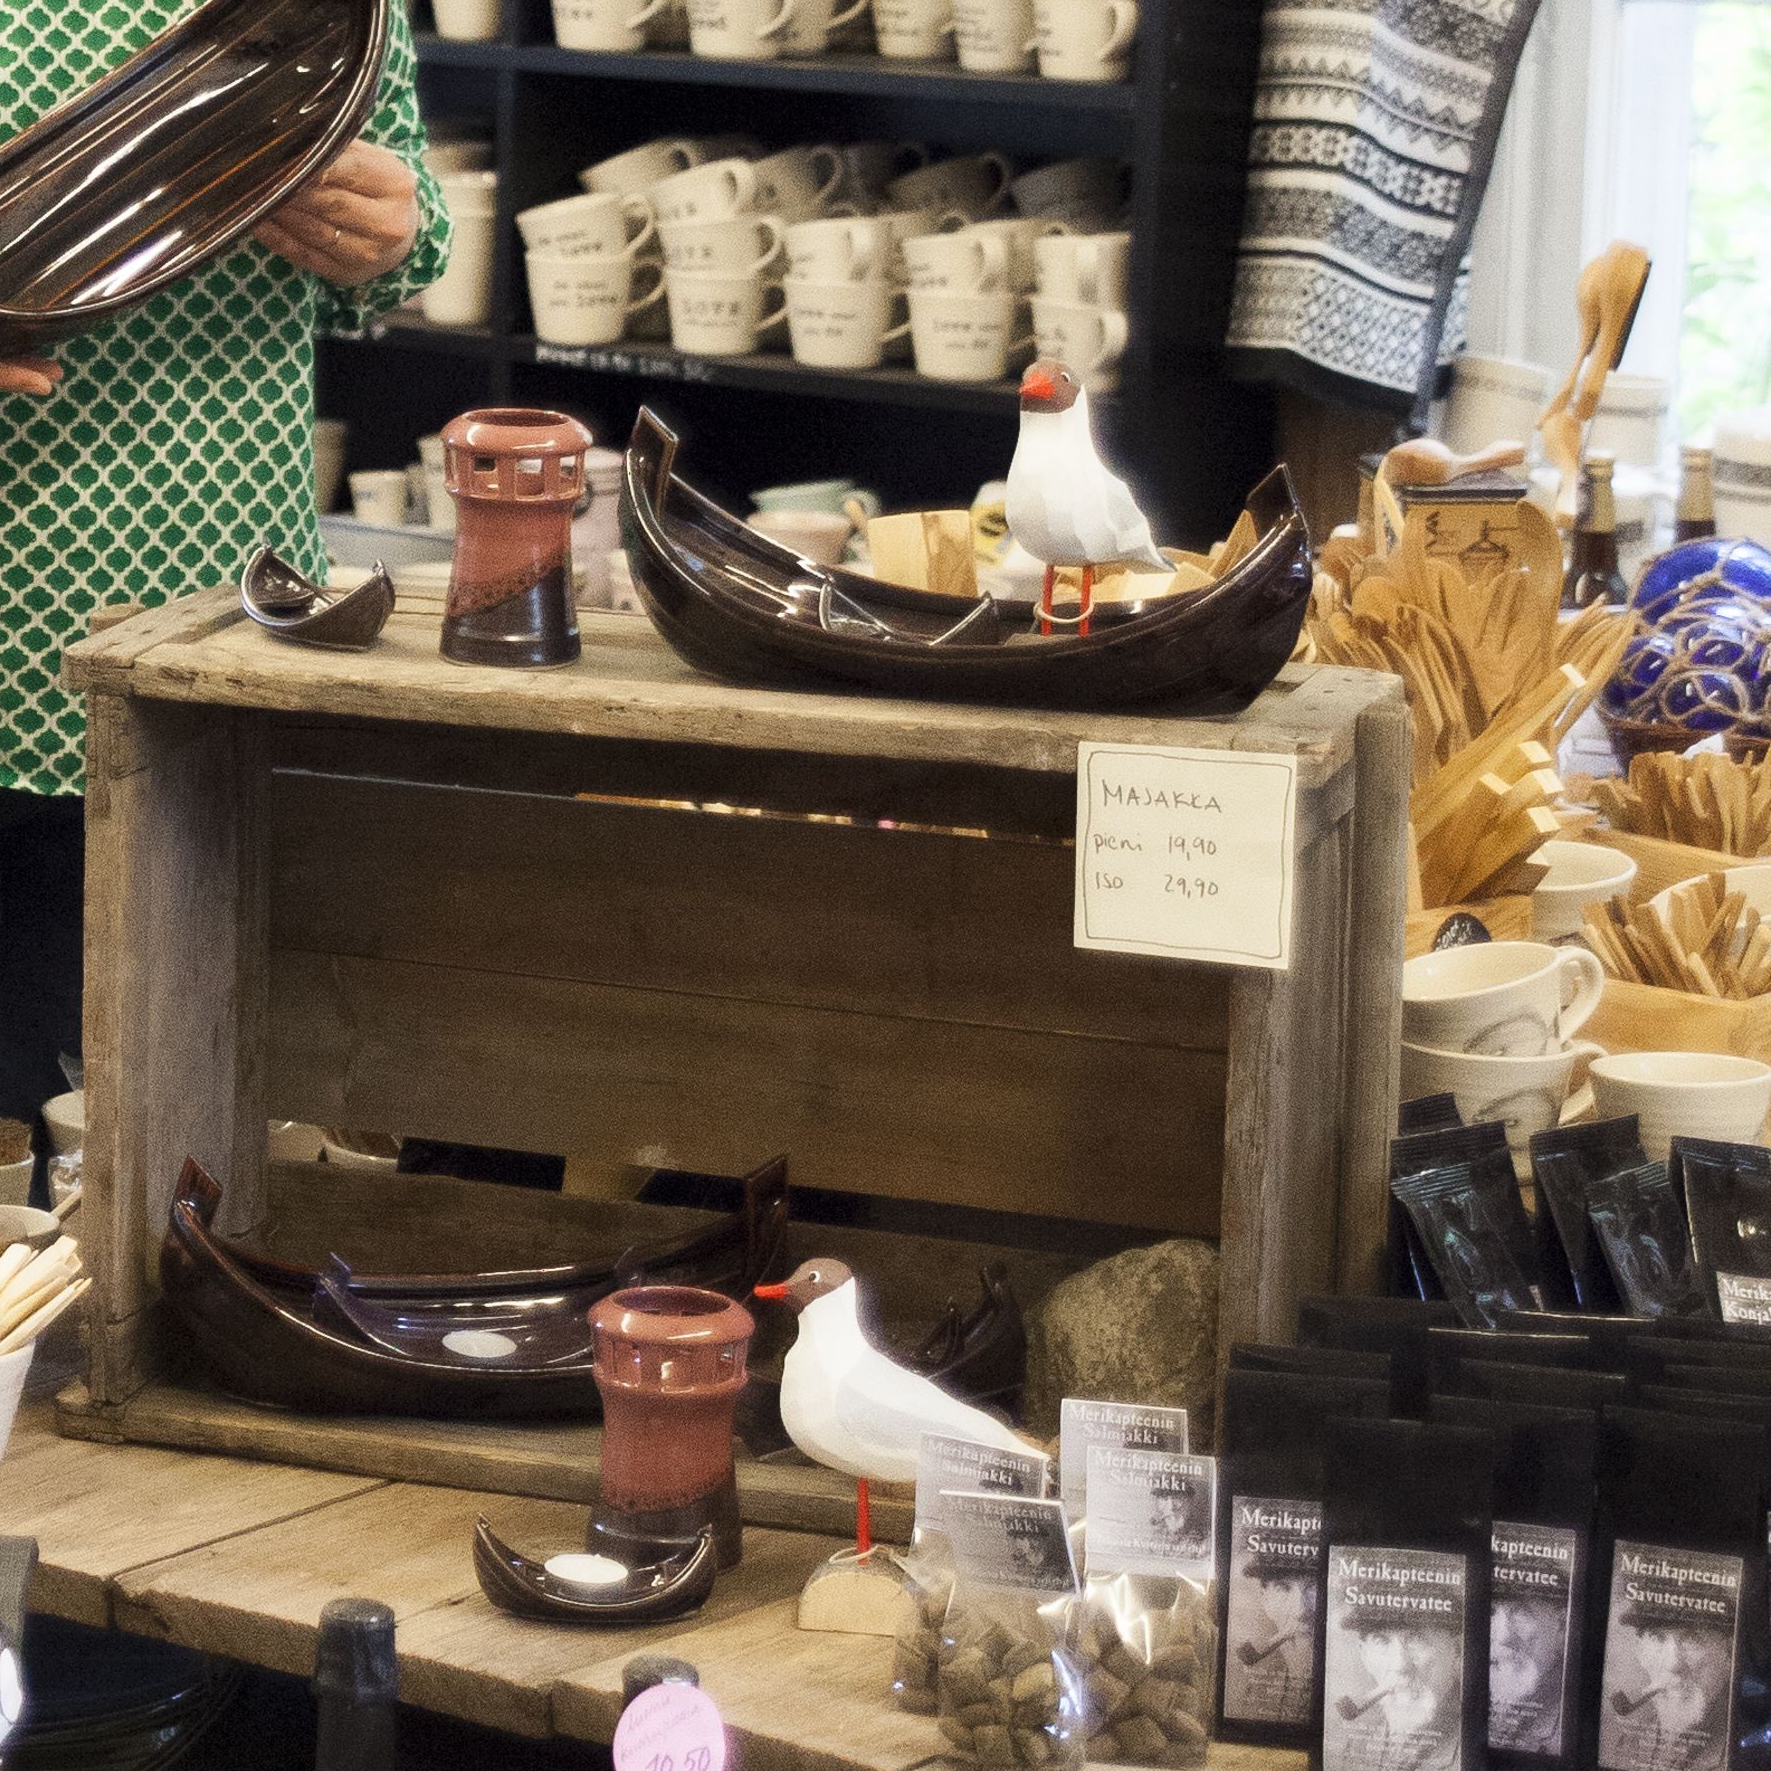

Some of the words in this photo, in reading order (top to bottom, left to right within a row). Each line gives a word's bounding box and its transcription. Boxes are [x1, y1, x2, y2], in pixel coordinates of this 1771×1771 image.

[1101, 779, 1223, 814] MAJAKKA
[1168, 835, 1218, 862] 19,90
[1164, 874, 1219, 899] 29,90
[1721, 1278, 1771, 1301] Merik
[1723, 1300, 1771, 1325] Konja
[1068, 1404, 1175, 1430] Merikapteenin
[1084, 1423, 1159, 1445] Salmiakki
[927, 1438, 1031, 1474] Merikapteenin
[1094, 1450, 1204, 1476] Merikapteenin
[942, 1459, 1014, 1487] Salmiakki
[1108, 1469, 1187, 1492] Salmiakki
[1490, 1534, 1569, 1561] kapteenin
[1338, 1557, 1462, 1587] Merikapteenin
[1493, 1564, 1559, 1587] tervatee
[1619, 1552, 1737, 1588] Merikapteenin
[1344, 1586, 1453, 1613] Savutervatee
[1624, 1582, 1727, 1615] Savutervatee
